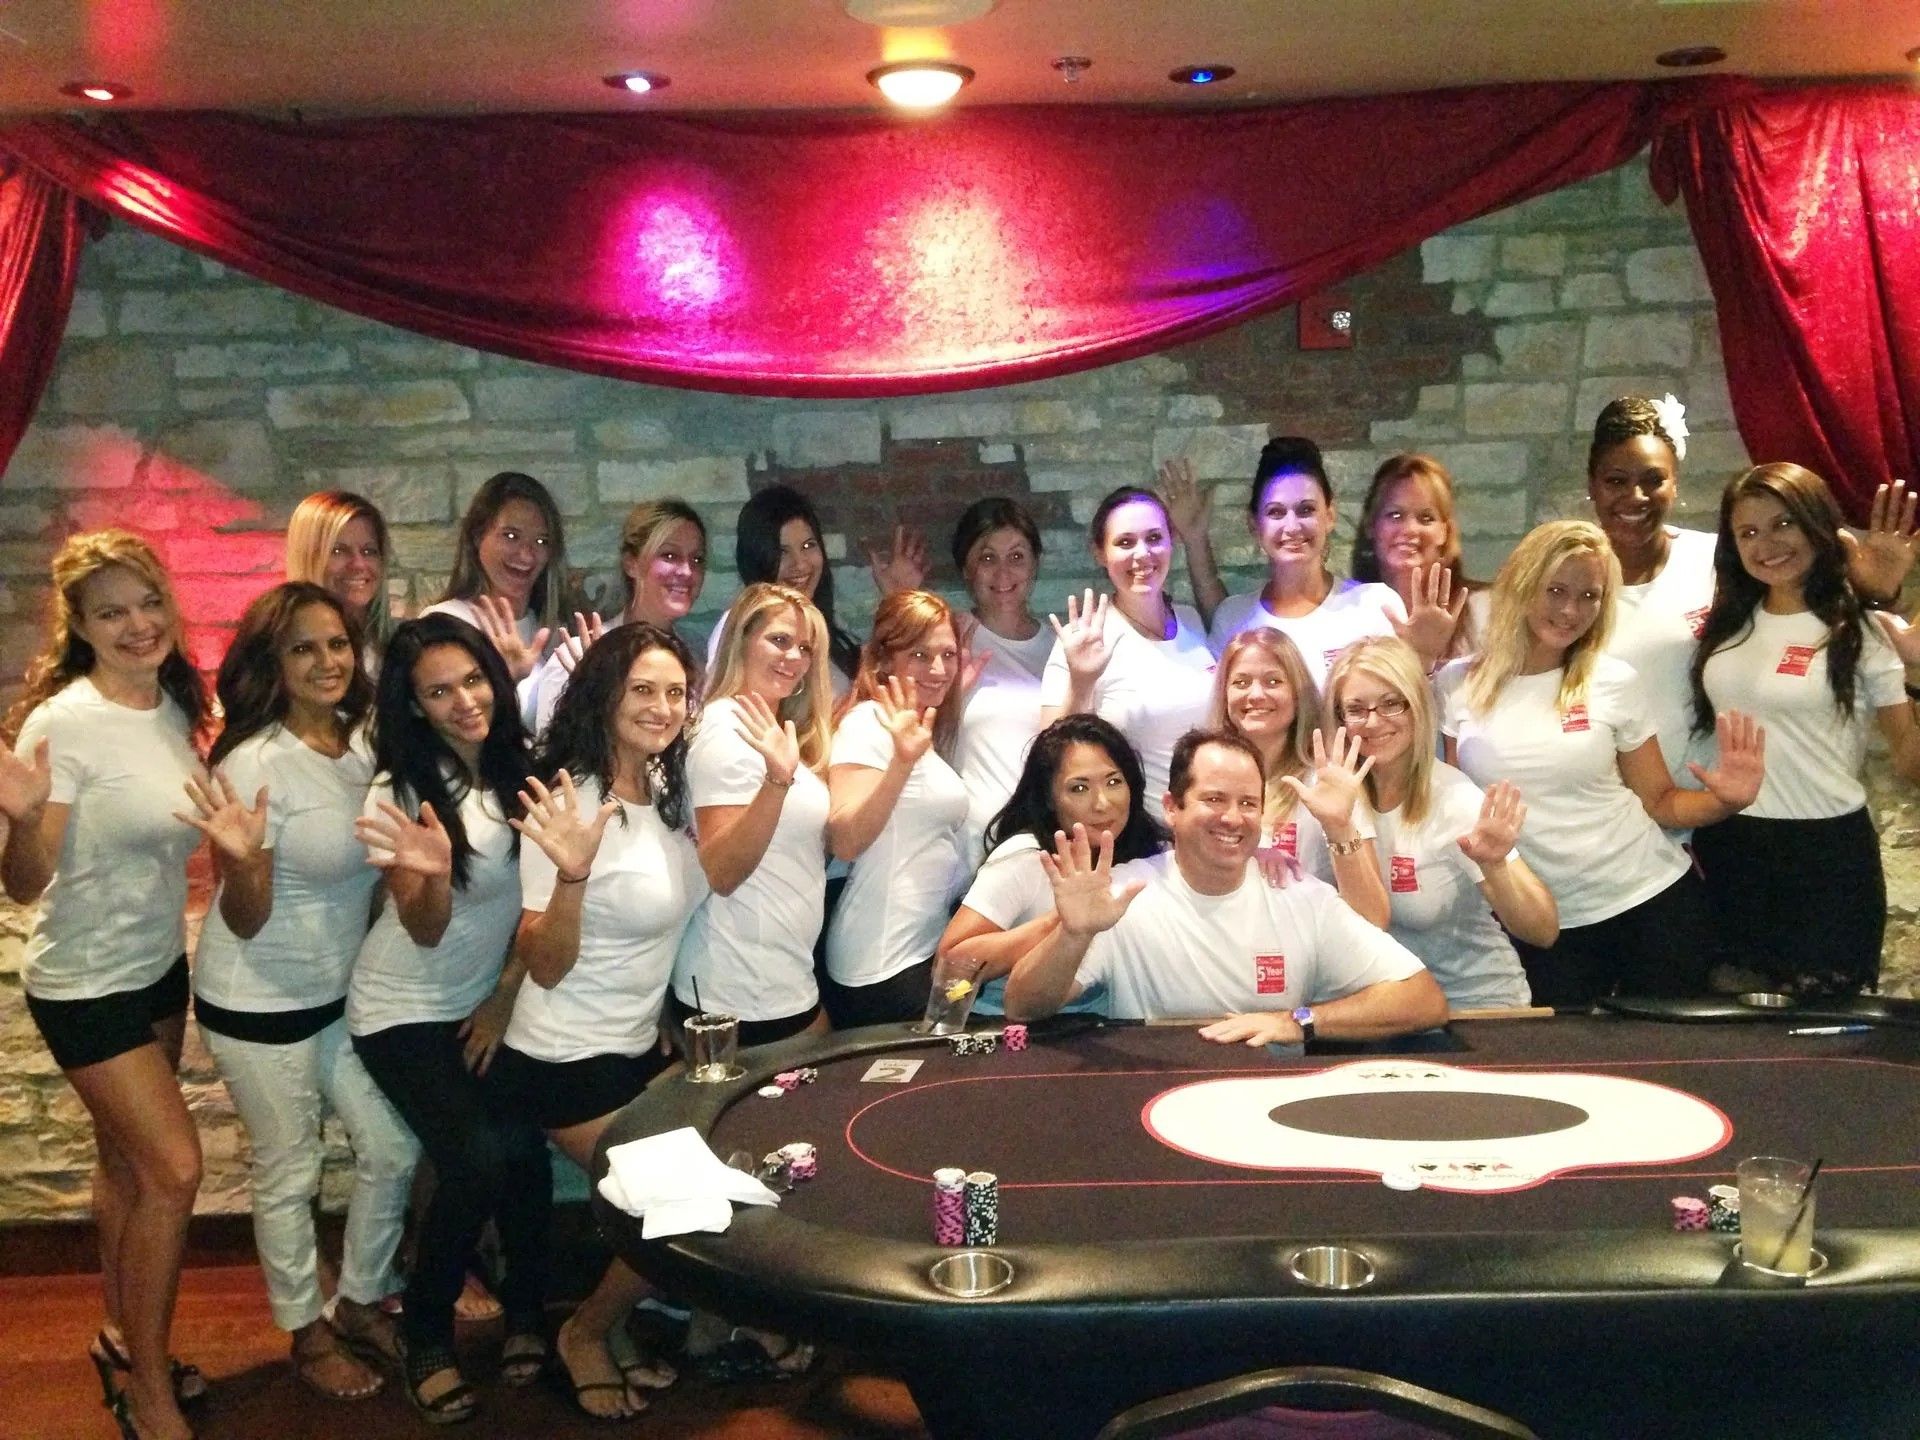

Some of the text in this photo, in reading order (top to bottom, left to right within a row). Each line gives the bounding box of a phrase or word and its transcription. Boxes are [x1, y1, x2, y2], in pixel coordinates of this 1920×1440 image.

[1391, 866, 1398, 880] 5
[1257, 966, 1284, 982] 5 Year
[870, 1067, 907, 1081] 2
